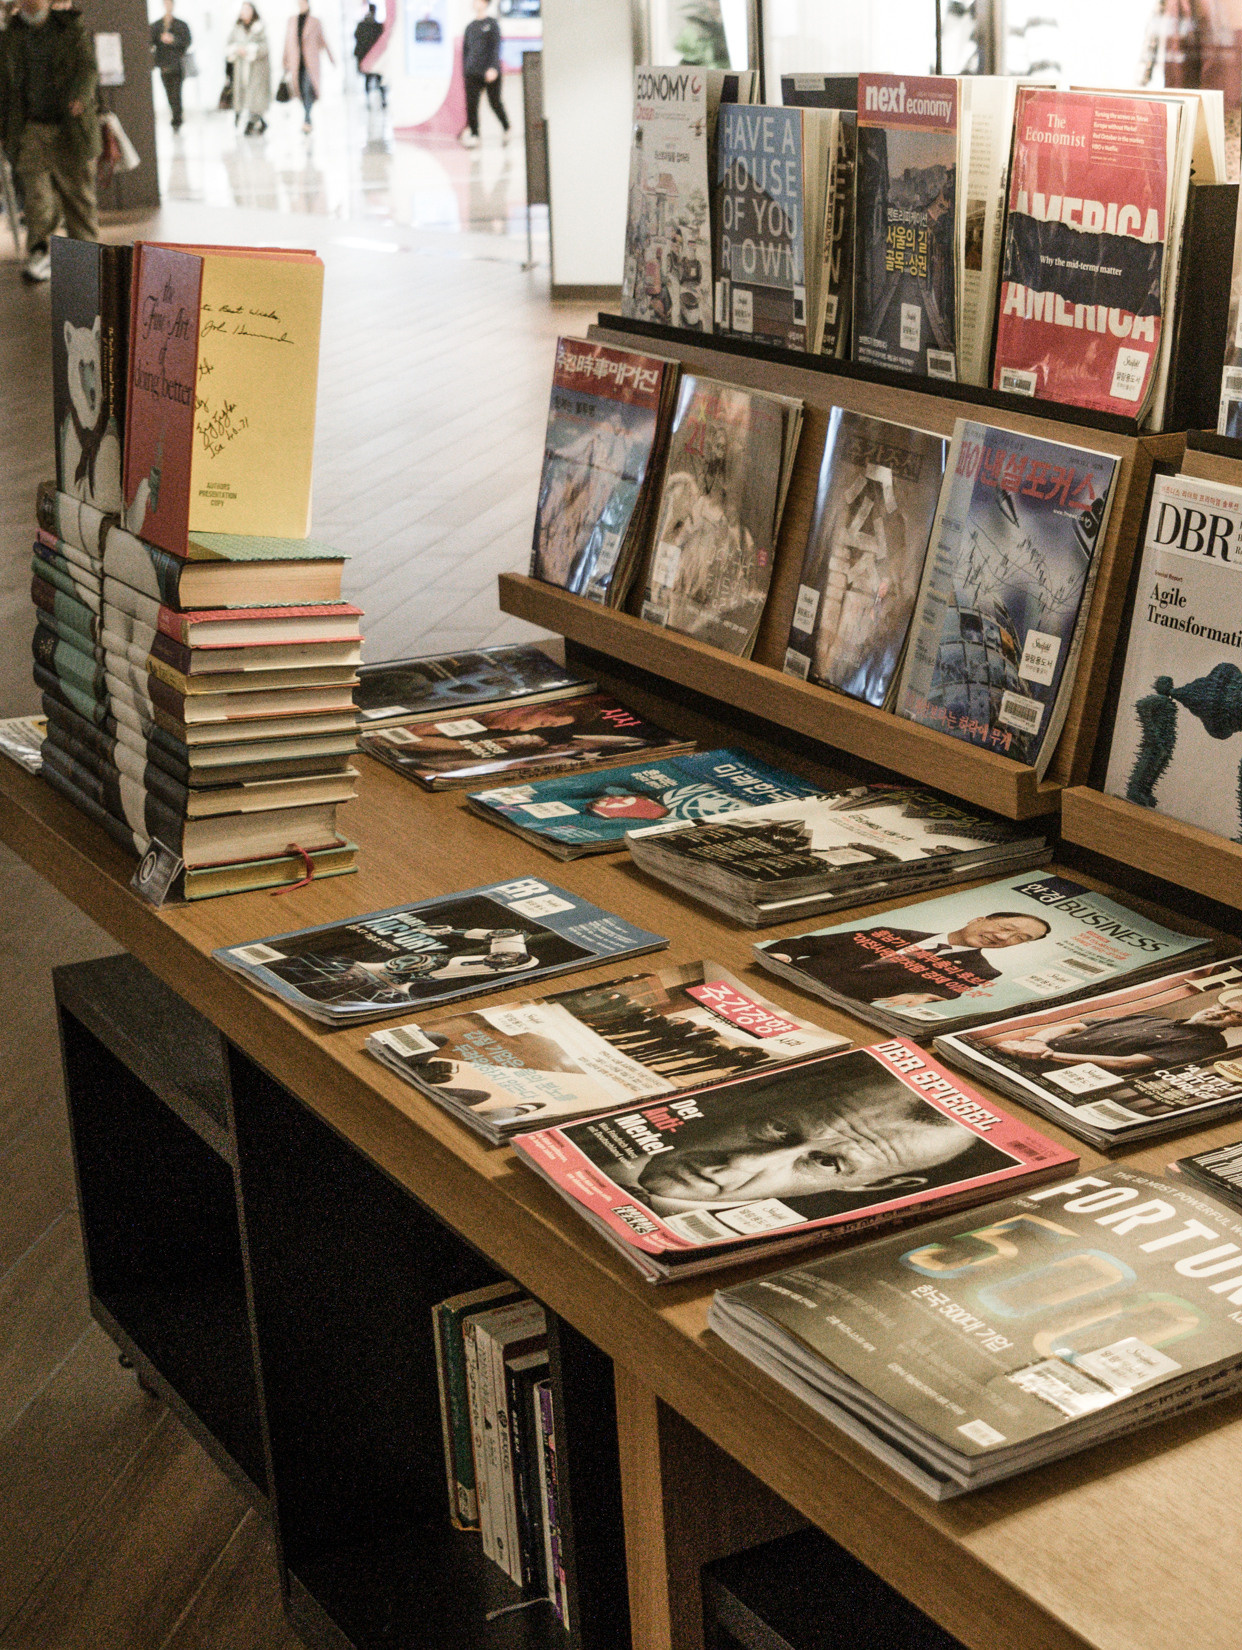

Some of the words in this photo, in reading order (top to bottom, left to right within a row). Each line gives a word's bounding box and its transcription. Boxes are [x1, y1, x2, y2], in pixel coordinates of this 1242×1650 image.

[637, 74, 689, 101] ECONOMY
[865, 83, 906, 113] next
[905, 97, 953, 123] economy
[724, 113, 775, 154] HAVE
[782, 118, 796, 155] A
[1025, 127, 1086, 148] Economist
[1047, 113, 1066, 129] The
[723, 154, 797, 198] HOUSE
[722, 194, 745, 231] OF
[752, 198, 798, 240] YOU
[741, 238, 800, 280] OWN
[886, 225, 917, 251] 서울의
[918, 231, 929, 256] 길
[1039, 255, 1055, 267] Why
[1055, 257, 1066, 267] the
[1066, 259, 1100, 273] mid-terms
[1100, 265, 1123, 277] matter
[198, 490, 238, 499] PRESENTATION
[954, 440, 1097, 513] 파이낸셜포커스
[210, 499, 225, 508] COPY
[1153, 501, 1235, 563] DBR
[1150, 582, 1187, 610] Agile
[1026, 881, 1061, 907] 한경
[1056, 896, 1170, 954] BUSINESS
[699, 982, 795, 1037] 주간경향
[463, 1029, 497, 1047] 갑질
[485, 1043, 525, 1069] 기업은
[870, 1039, 919, 1075] DER
[909, 1065, 1001, 1132] SPIEGEL
[1179, 1072, 1208, 1087] BIT
[1202, 1082, 1222, 1093] OF
[640, 1105, 685, 1134] Anti-
[668, 1098, 705, 1120] Der
[613, 1112, 676, 1156] Merkel
[1113, 1171, 1131, 1183] THE
[1146, 1180, 1176, 1196] MOST
[1173, 1189, 1233, 1228] POWERFUL
[610, 1206, 651, 1236] LEAKS
[909, 1283, 951, 1309] 한국
[938, 1302, 986, 1334] 500대
[974, 1328, 1015, 1353] 기업
